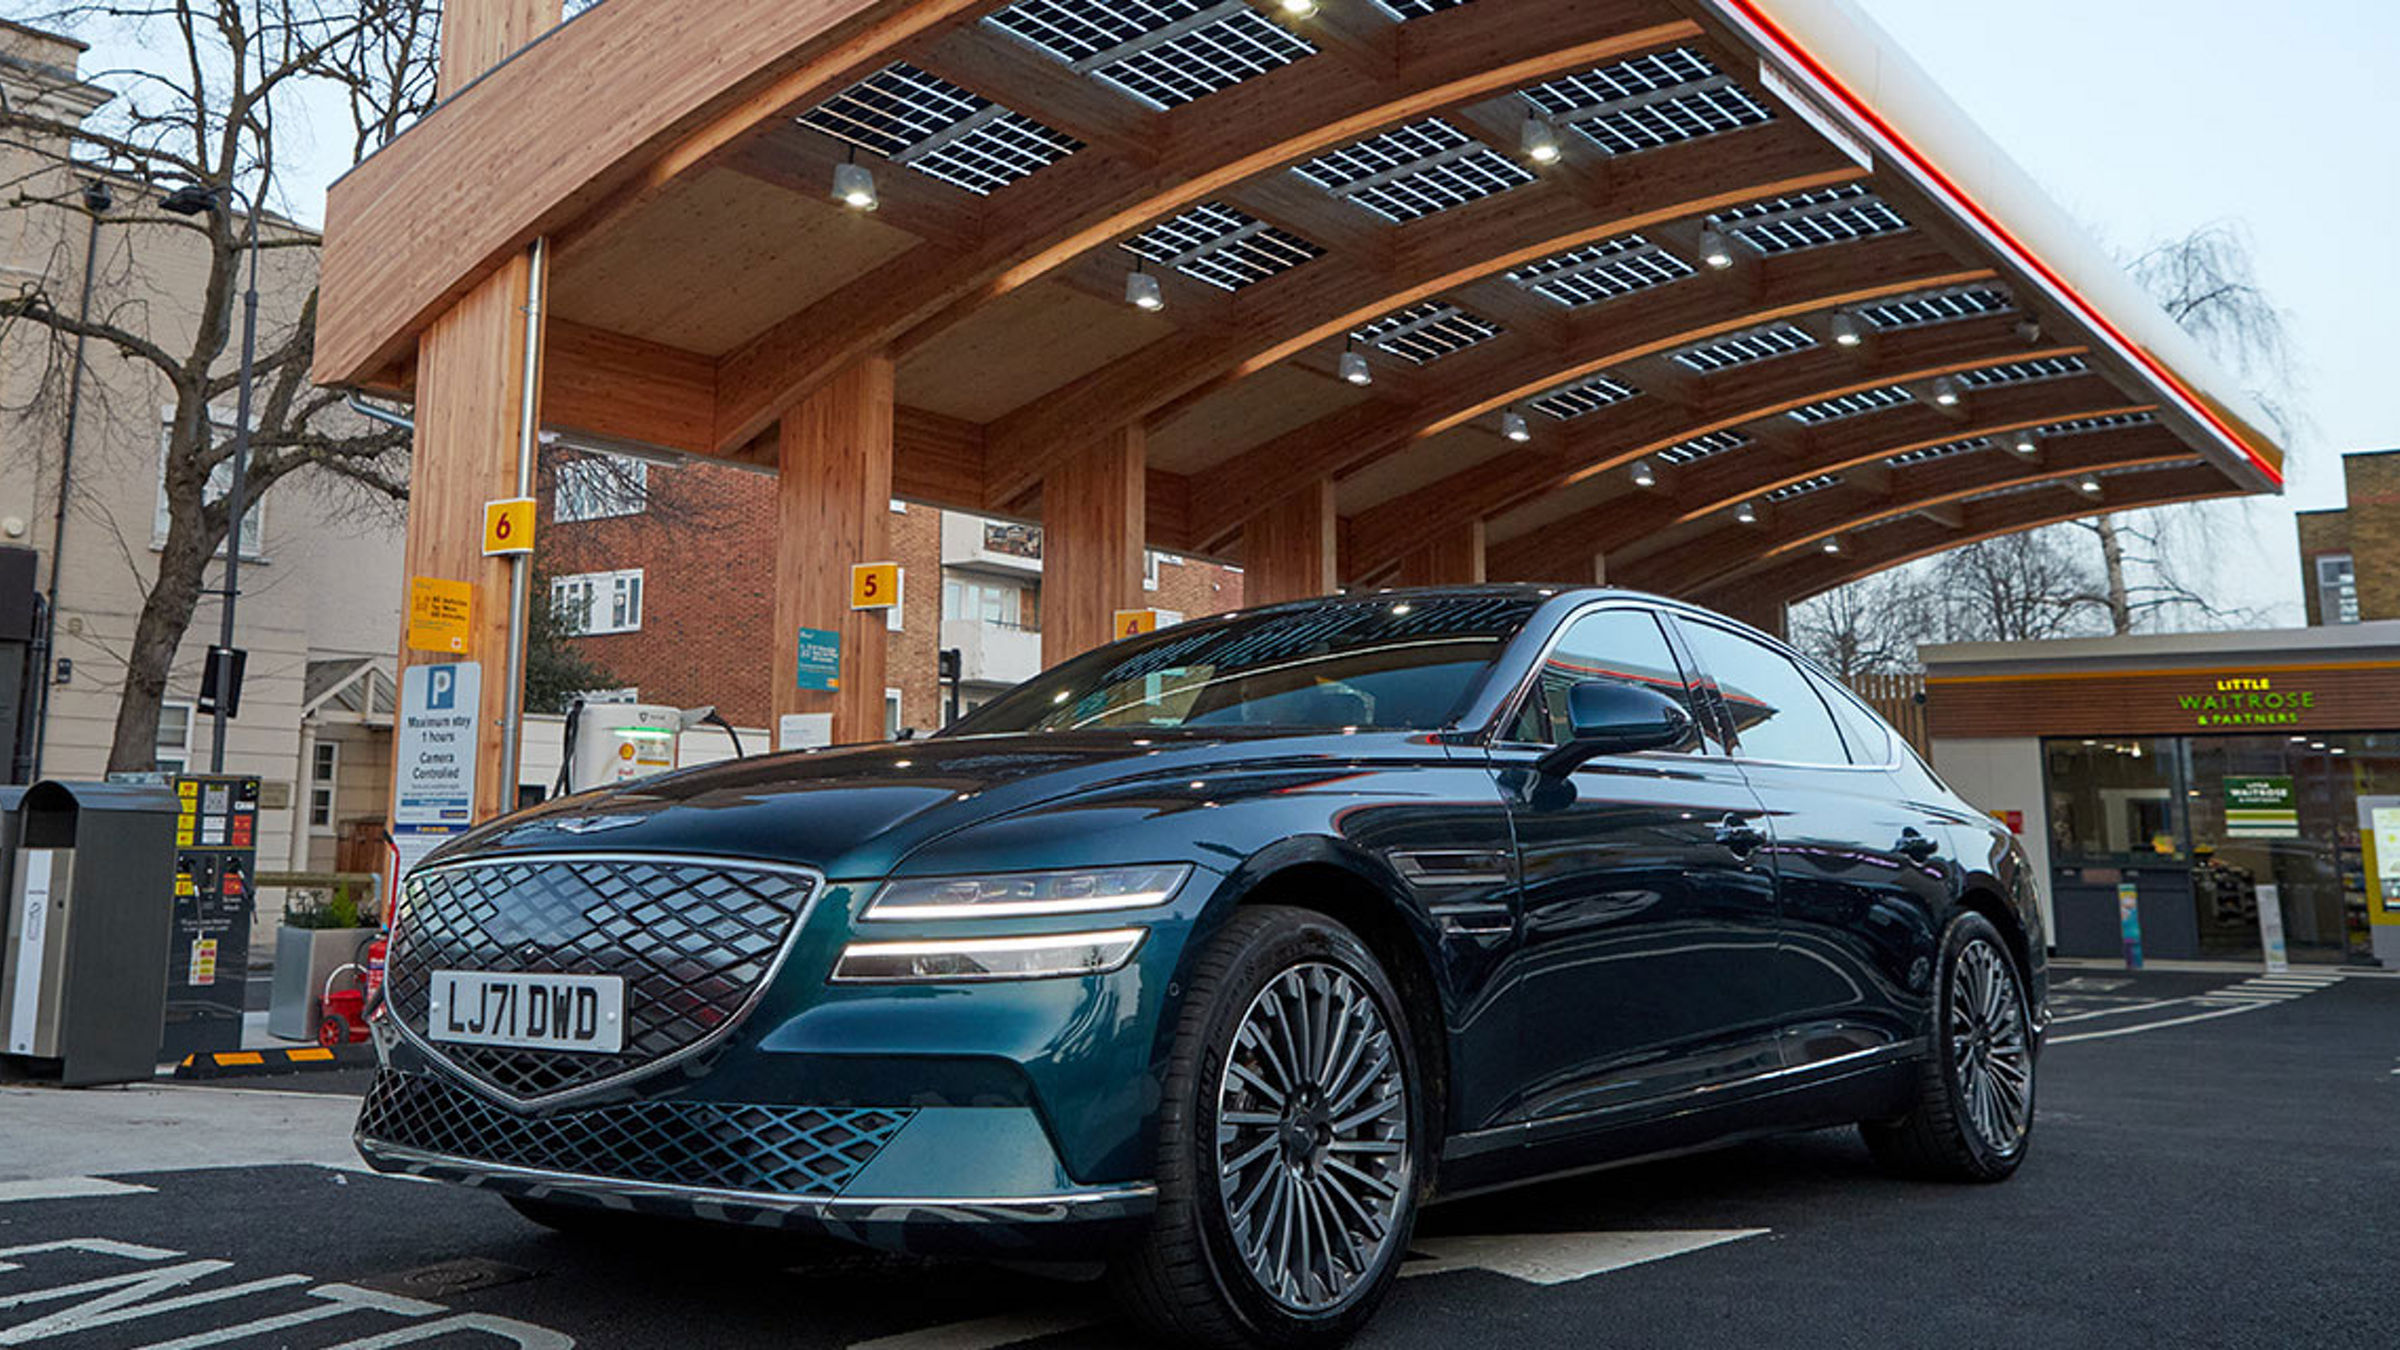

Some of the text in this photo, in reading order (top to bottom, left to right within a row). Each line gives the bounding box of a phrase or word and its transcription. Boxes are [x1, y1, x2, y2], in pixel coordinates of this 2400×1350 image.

[496, 512, 511, 540] 6
[864, 574, 877, 597] 5
[1126, 620, 1139, 635] 4
[433, 671, 451, 705] P
[2217, 678, 2270, 690] LITTLE
[2178, 692, 2314, 709] WAITROSE
[408, 716, 471, 730] Maximum stay
[2198, 712, 2298, 725] & PARTNERS
[422, 730, 455, 742] 1 hours
[419, 751, 454, 764] Camera
[412, 766, 460, 779] Controlled
[448, 980, 598, 1040] LJ71 DWD
